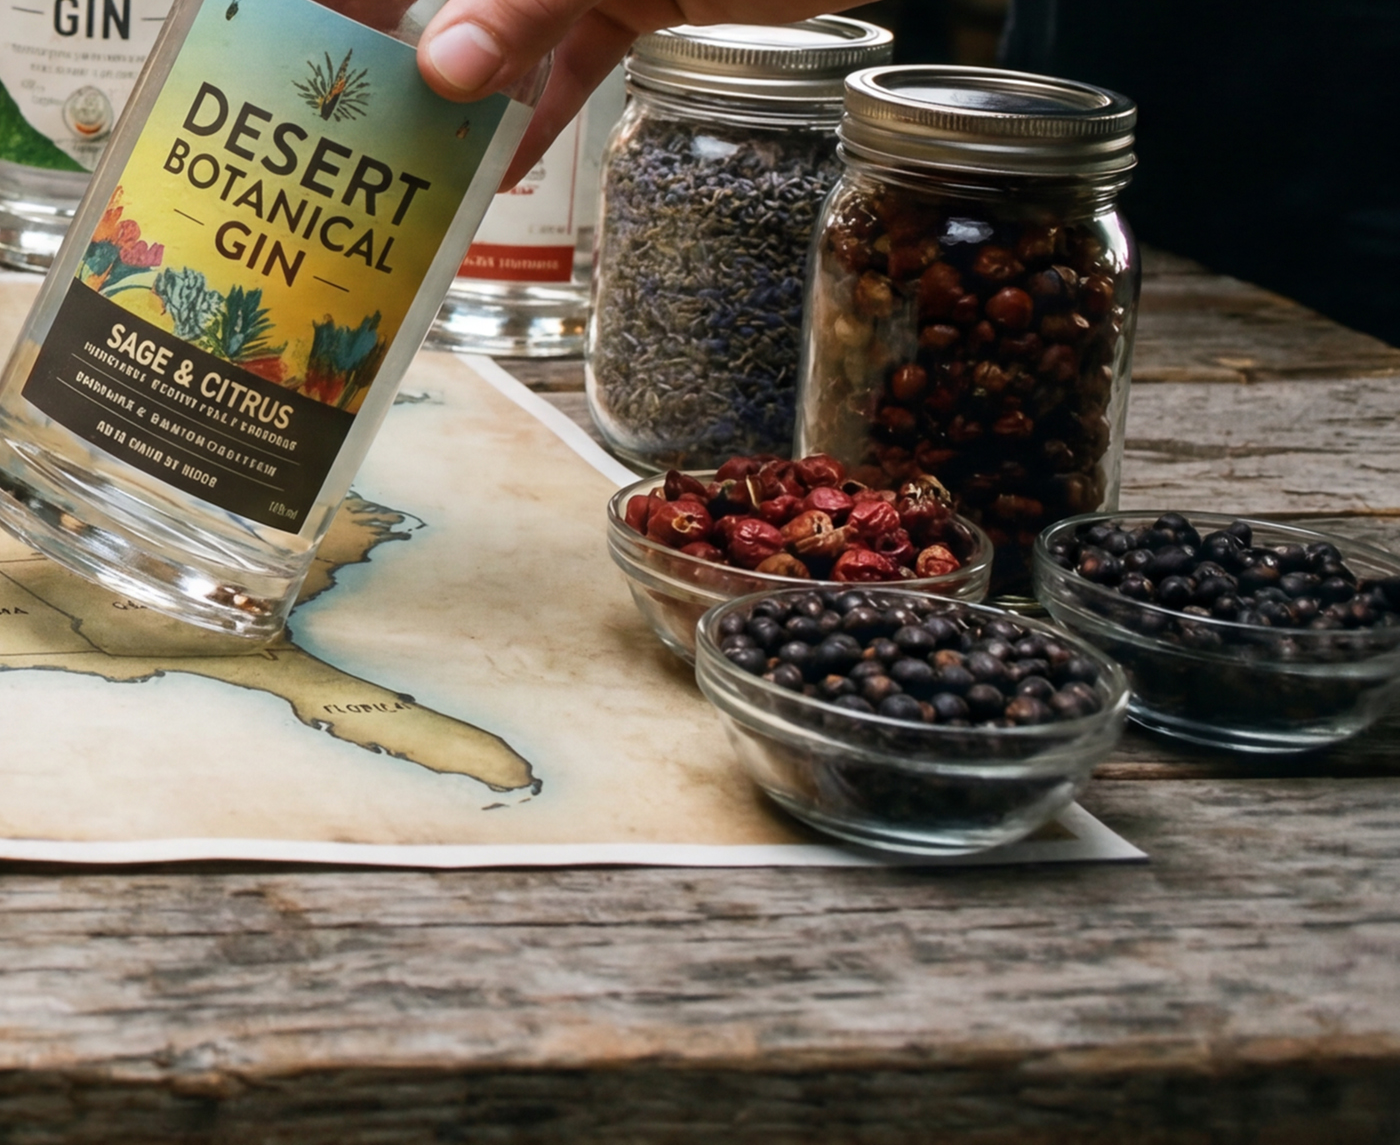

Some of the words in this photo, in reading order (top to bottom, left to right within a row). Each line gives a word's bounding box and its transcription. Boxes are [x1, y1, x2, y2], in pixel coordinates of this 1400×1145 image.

[162, 137, 396, 274] BOTANICAL
[181, 82, 430, 228] DESERT
[213, 221, 306, 288] GIN
[106, 322, 174, 375] SAGE
[173, 359, 195, 388] &
[200, 372, 294, 430] CITRUS
